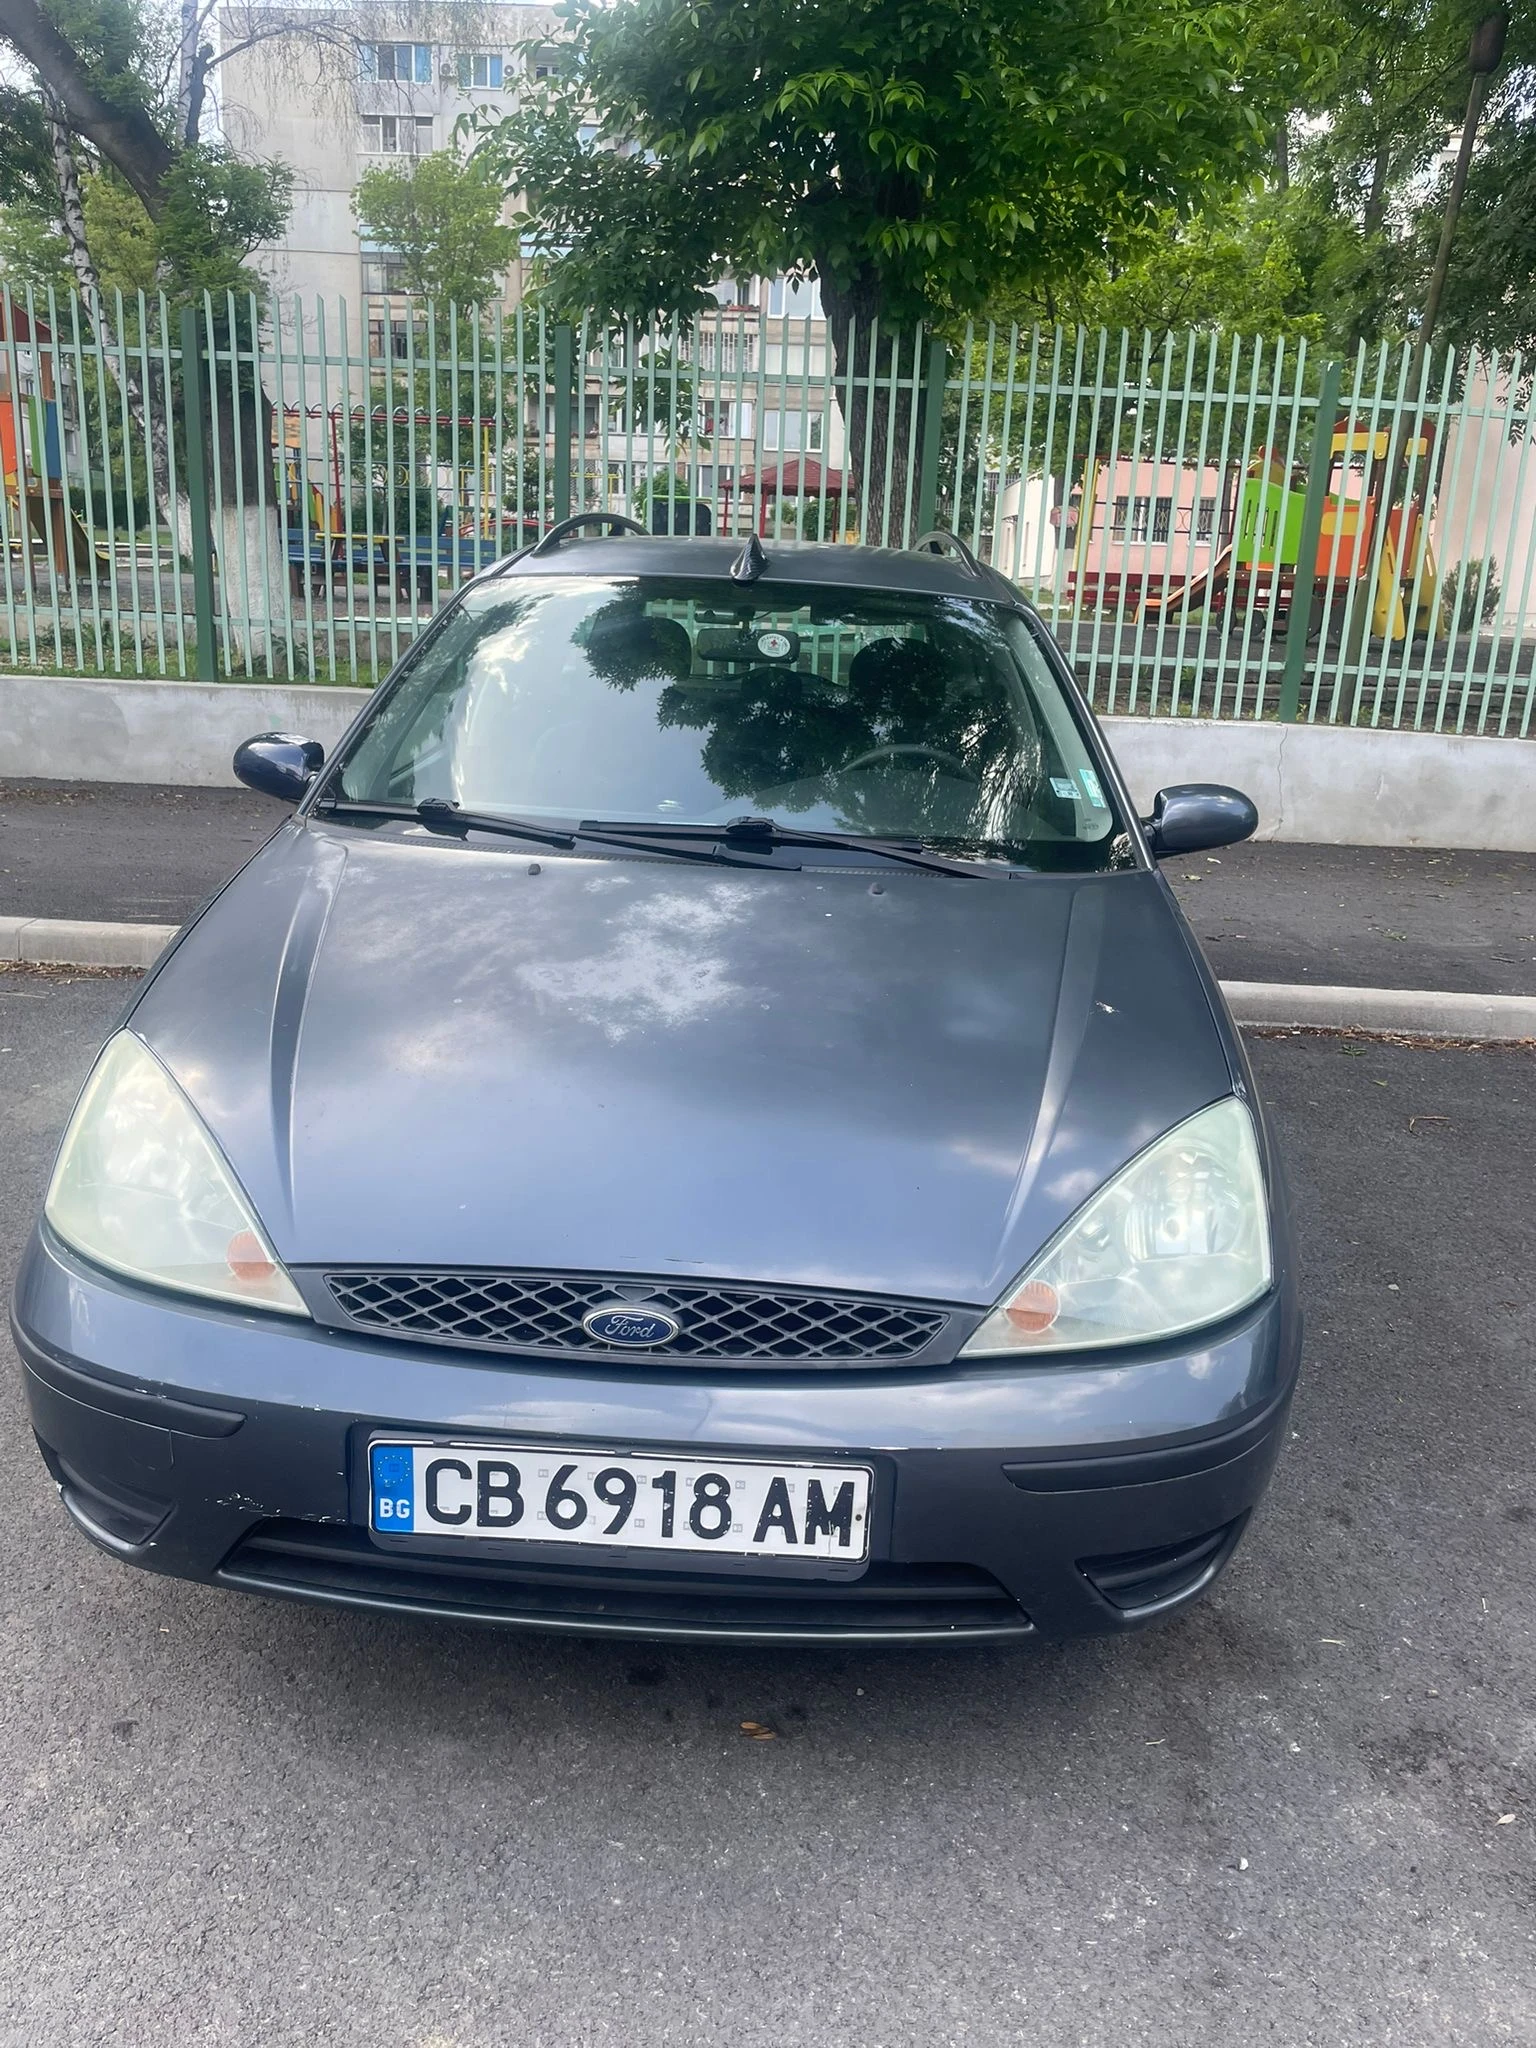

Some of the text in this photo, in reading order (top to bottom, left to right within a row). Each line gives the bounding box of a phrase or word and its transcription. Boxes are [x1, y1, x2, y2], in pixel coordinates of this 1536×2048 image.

[604, 1315, 656, 1338] Ford
[379, 1498, 411, 1520] BG
[425, 1458, 856, 1547] CB 6918 AM
